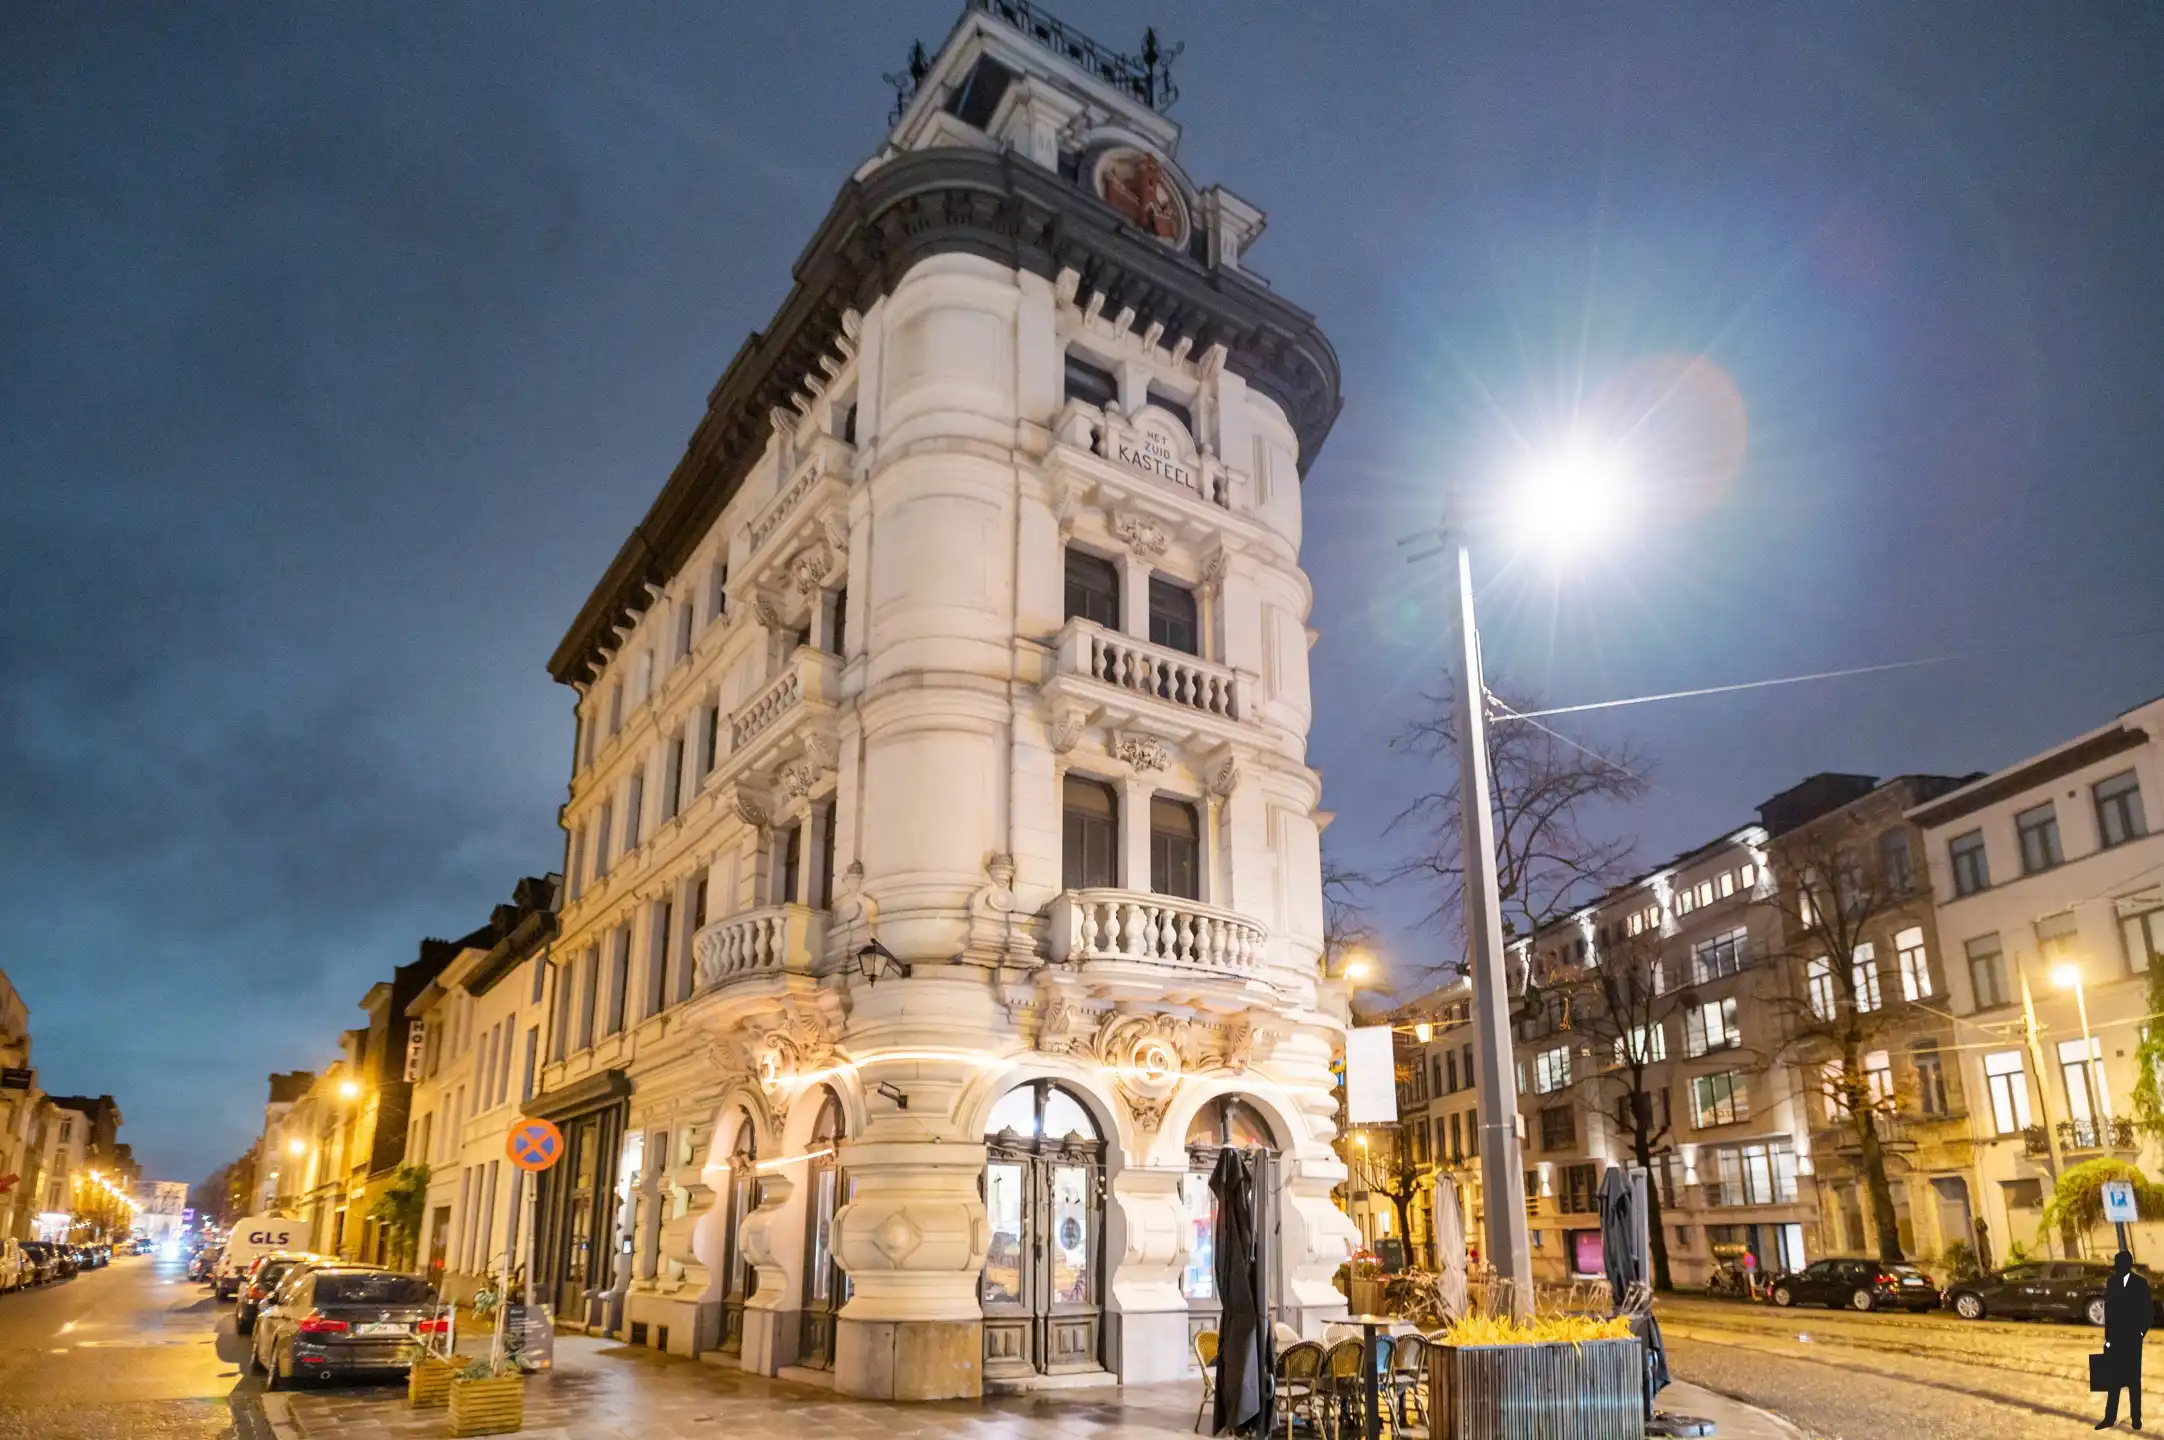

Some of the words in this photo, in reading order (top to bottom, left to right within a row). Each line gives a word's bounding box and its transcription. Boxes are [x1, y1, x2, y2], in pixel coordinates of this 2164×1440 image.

[1146, 430, 1169, 445] HET
[1144, 441, 1171, 459] ZUID
[1119, 444, 1195, 489] KASTEEL
[409, 1022, 424, 1081] HOTEL
[249, 1231, 290, 1245] GLS
